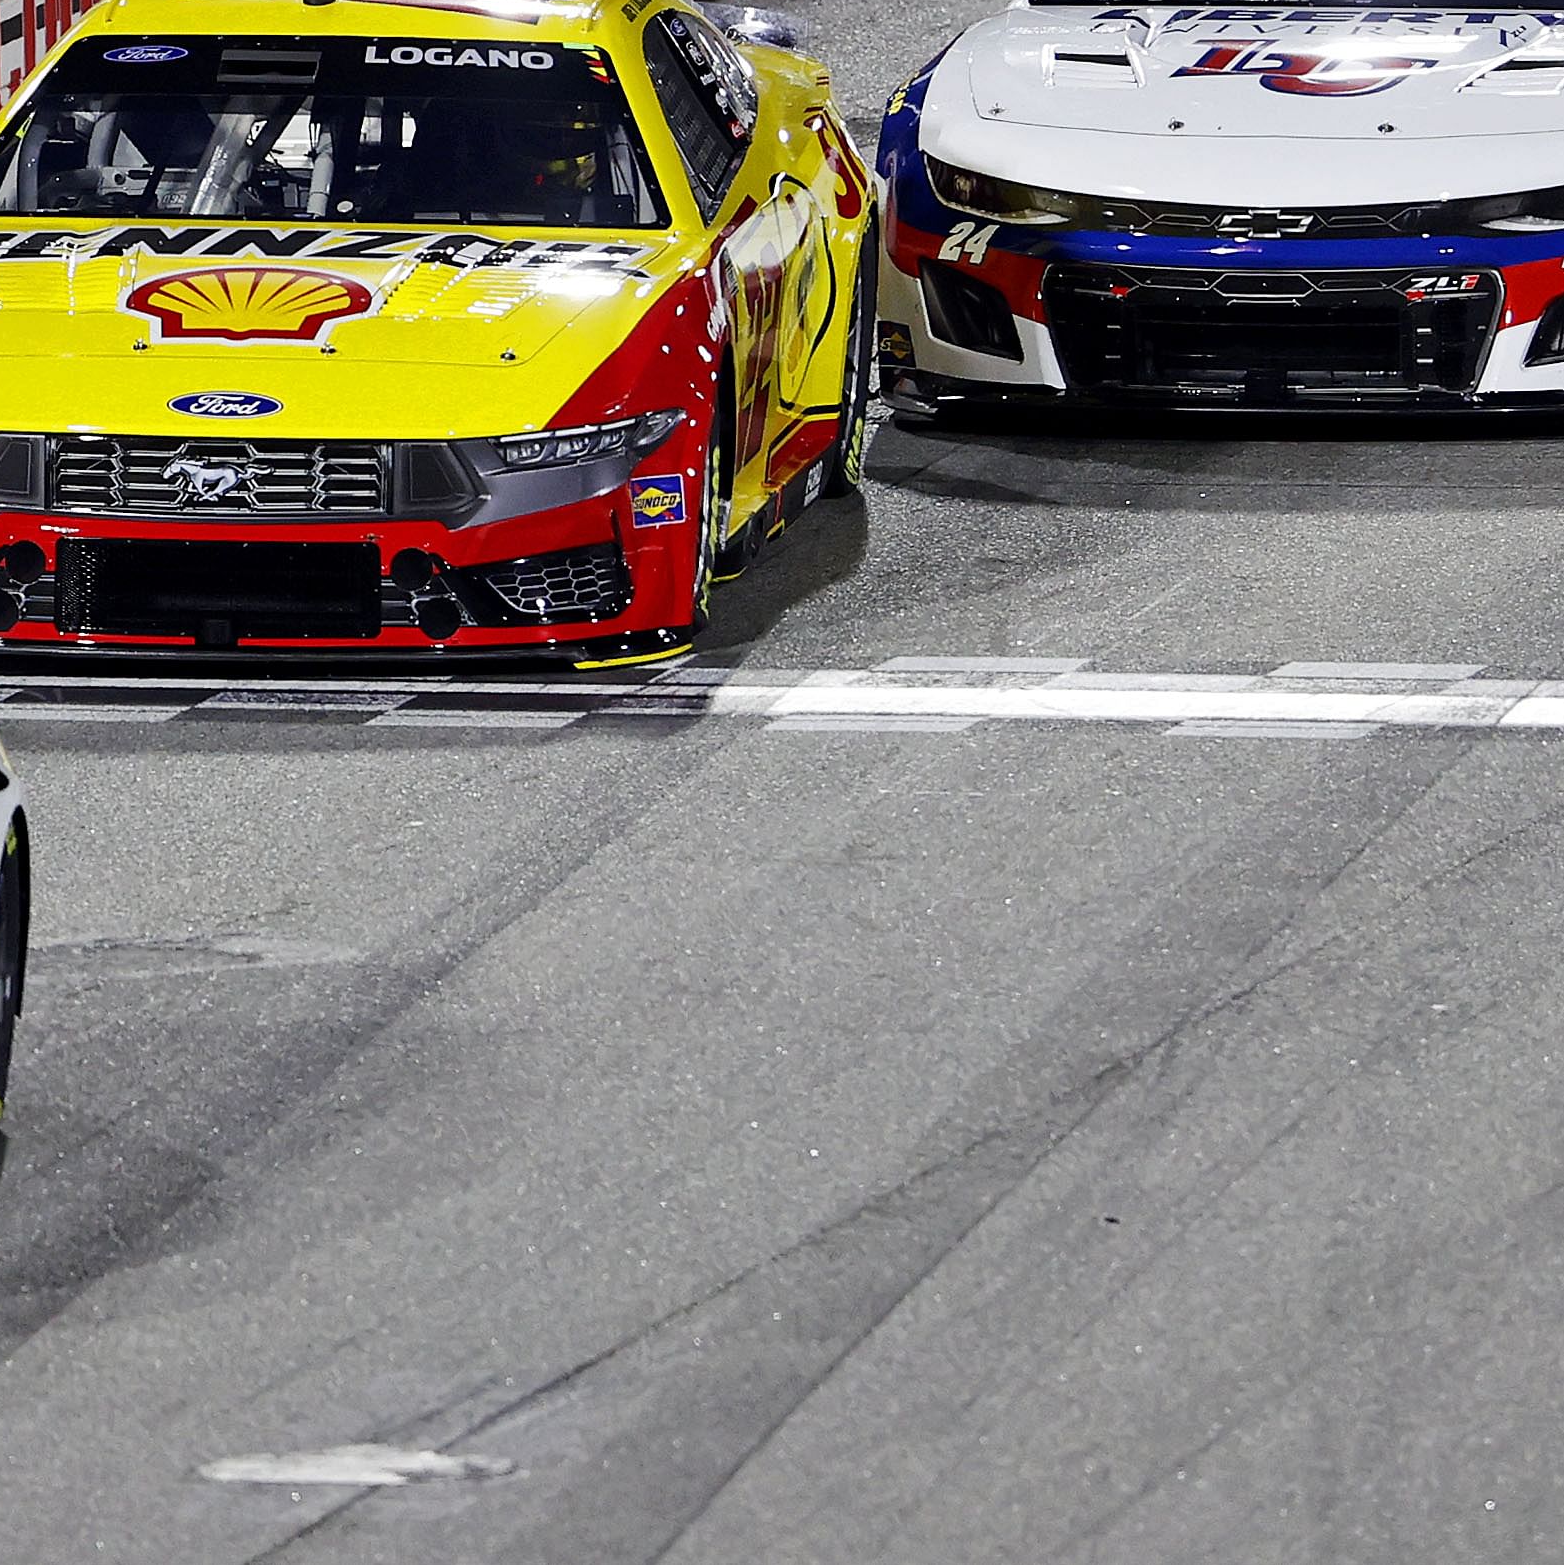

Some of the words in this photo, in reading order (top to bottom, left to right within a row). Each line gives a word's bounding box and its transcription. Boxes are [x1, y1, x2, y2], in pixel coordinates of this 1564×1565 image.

[115, 46, 175, 62] Ford
[365, 45, 554, 69] LOGANO
[937, 221, 1000, 264] 24
[188, 391, 259, 416] Ford
[633, 494, 681, 510] SUNOCO
